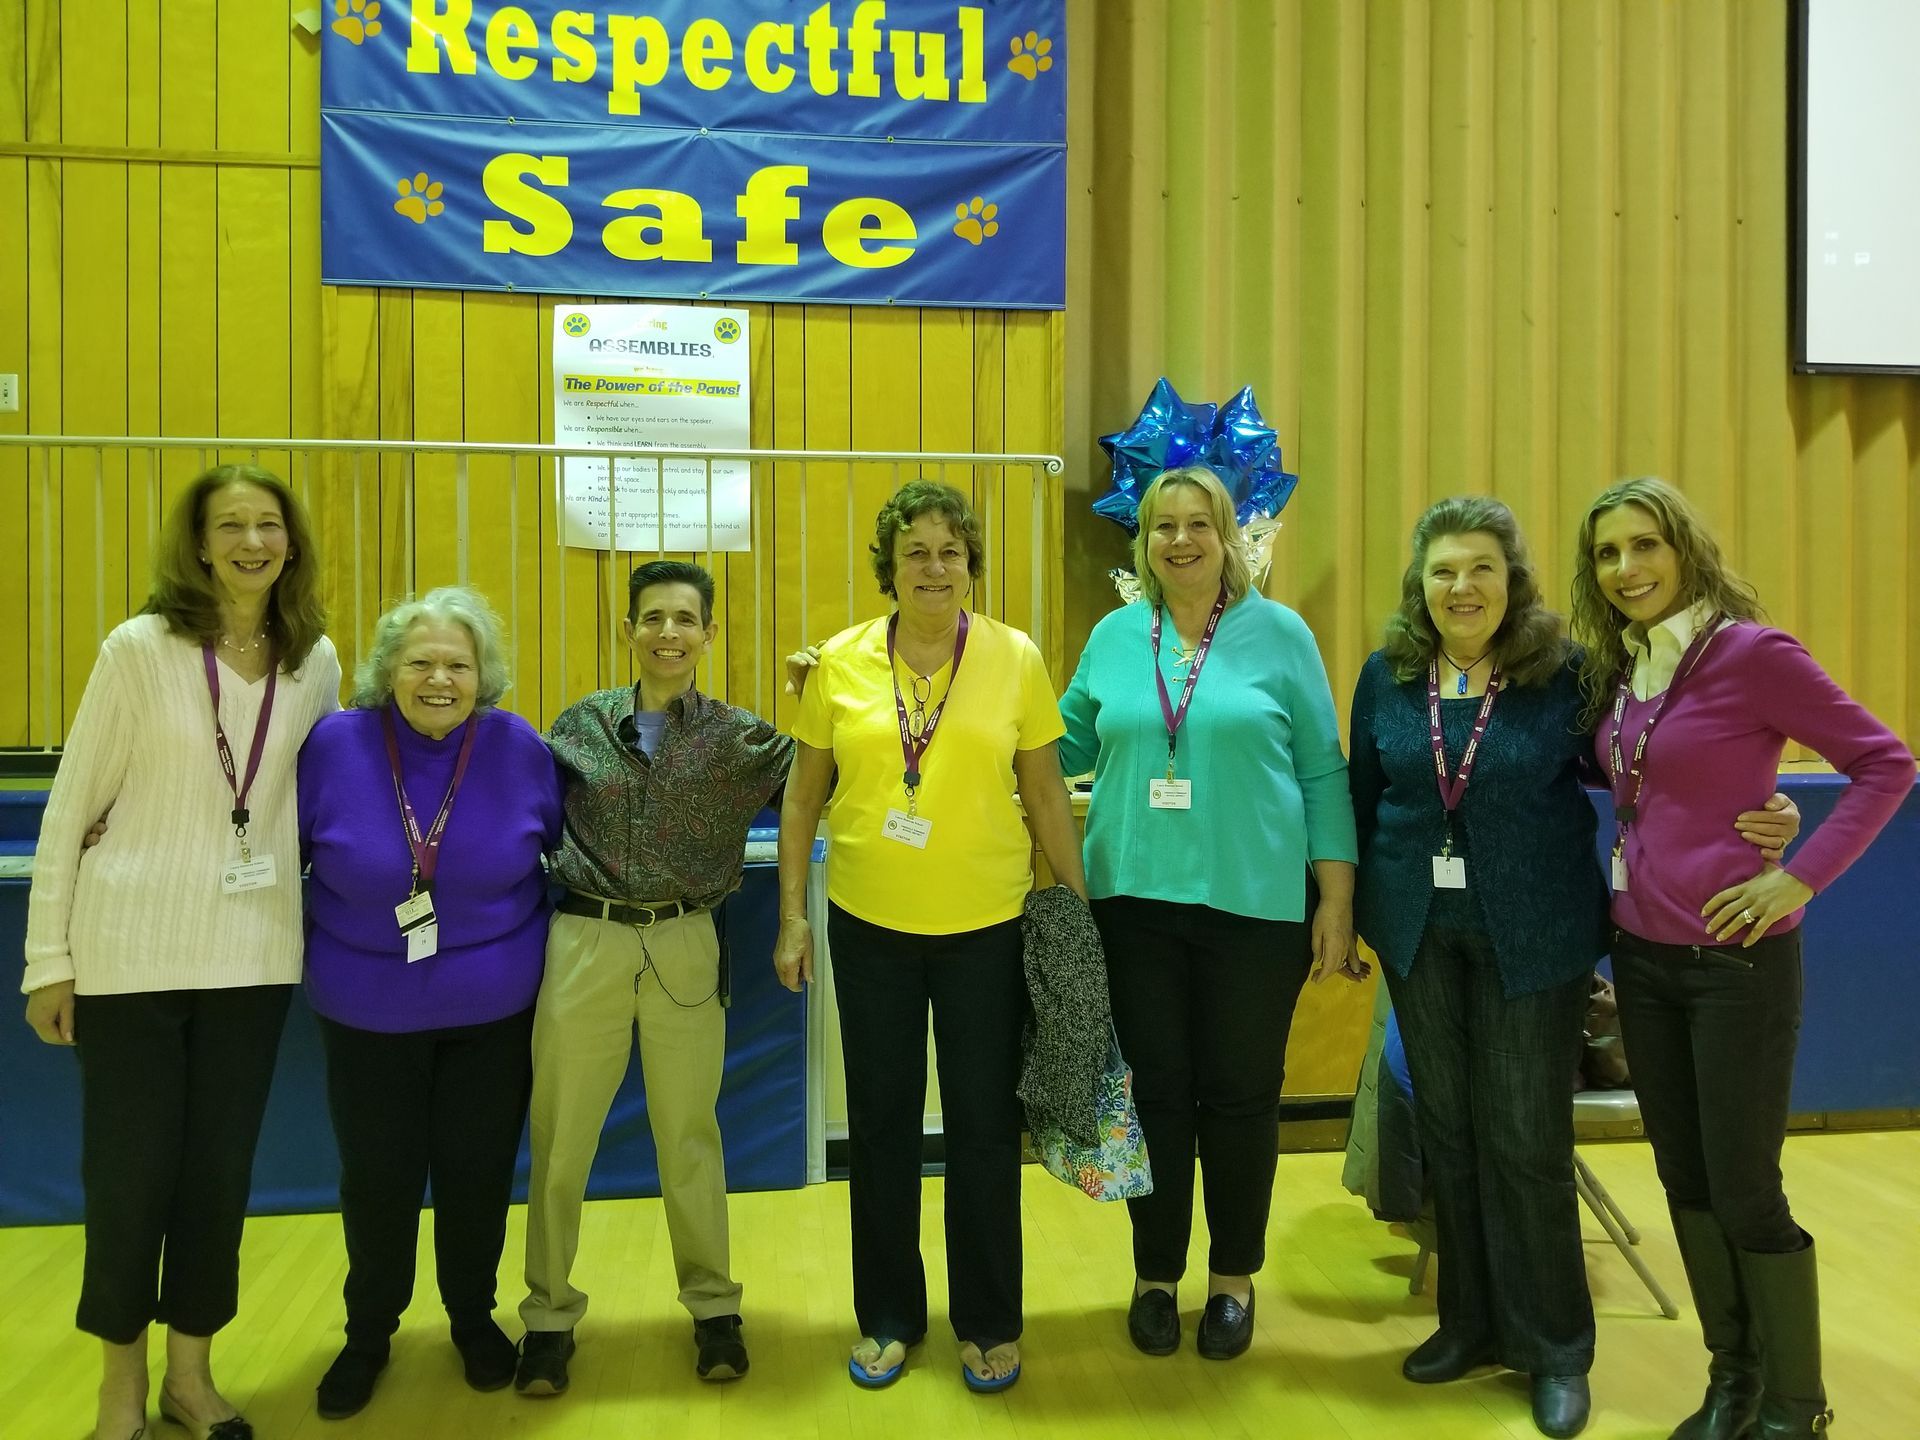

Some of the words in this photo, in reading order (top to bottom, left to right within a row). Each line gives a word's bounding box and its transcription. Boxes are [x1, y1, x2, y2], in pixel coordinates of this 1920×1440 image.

[406, 0, 988, 116] Respectful
[483, 152, 918, 269] Safe
[566, 378, 591, 390] The
[596, 379, 644, 391] Power
[649, 380, 664, 392] of
[668, 381, 692, 393] the
[697, 383, 741, 395] Paws!
[586, 400, 618, 409] Respectful
[587, 426, 622, 434] Responsible
